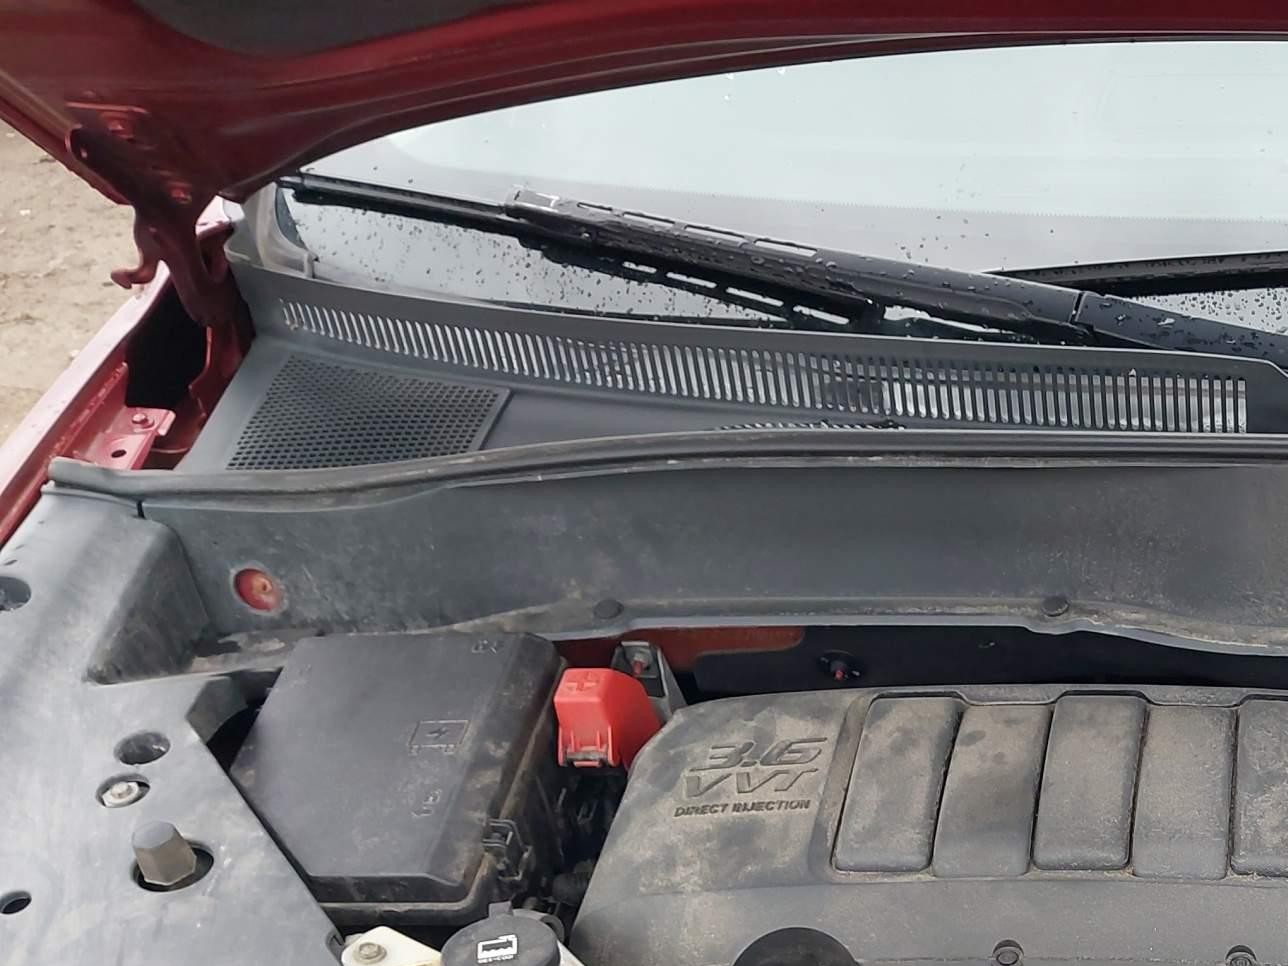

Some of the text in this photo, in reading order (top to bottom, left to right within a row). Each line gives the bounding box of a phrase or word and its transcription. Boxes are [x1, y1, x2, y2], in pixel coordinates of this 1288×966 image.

[690, 737, 828, 772] 3.6
[685, 768, 819, 798] VVT
[674, 799, 811, 817] DIRECT INJECTION
